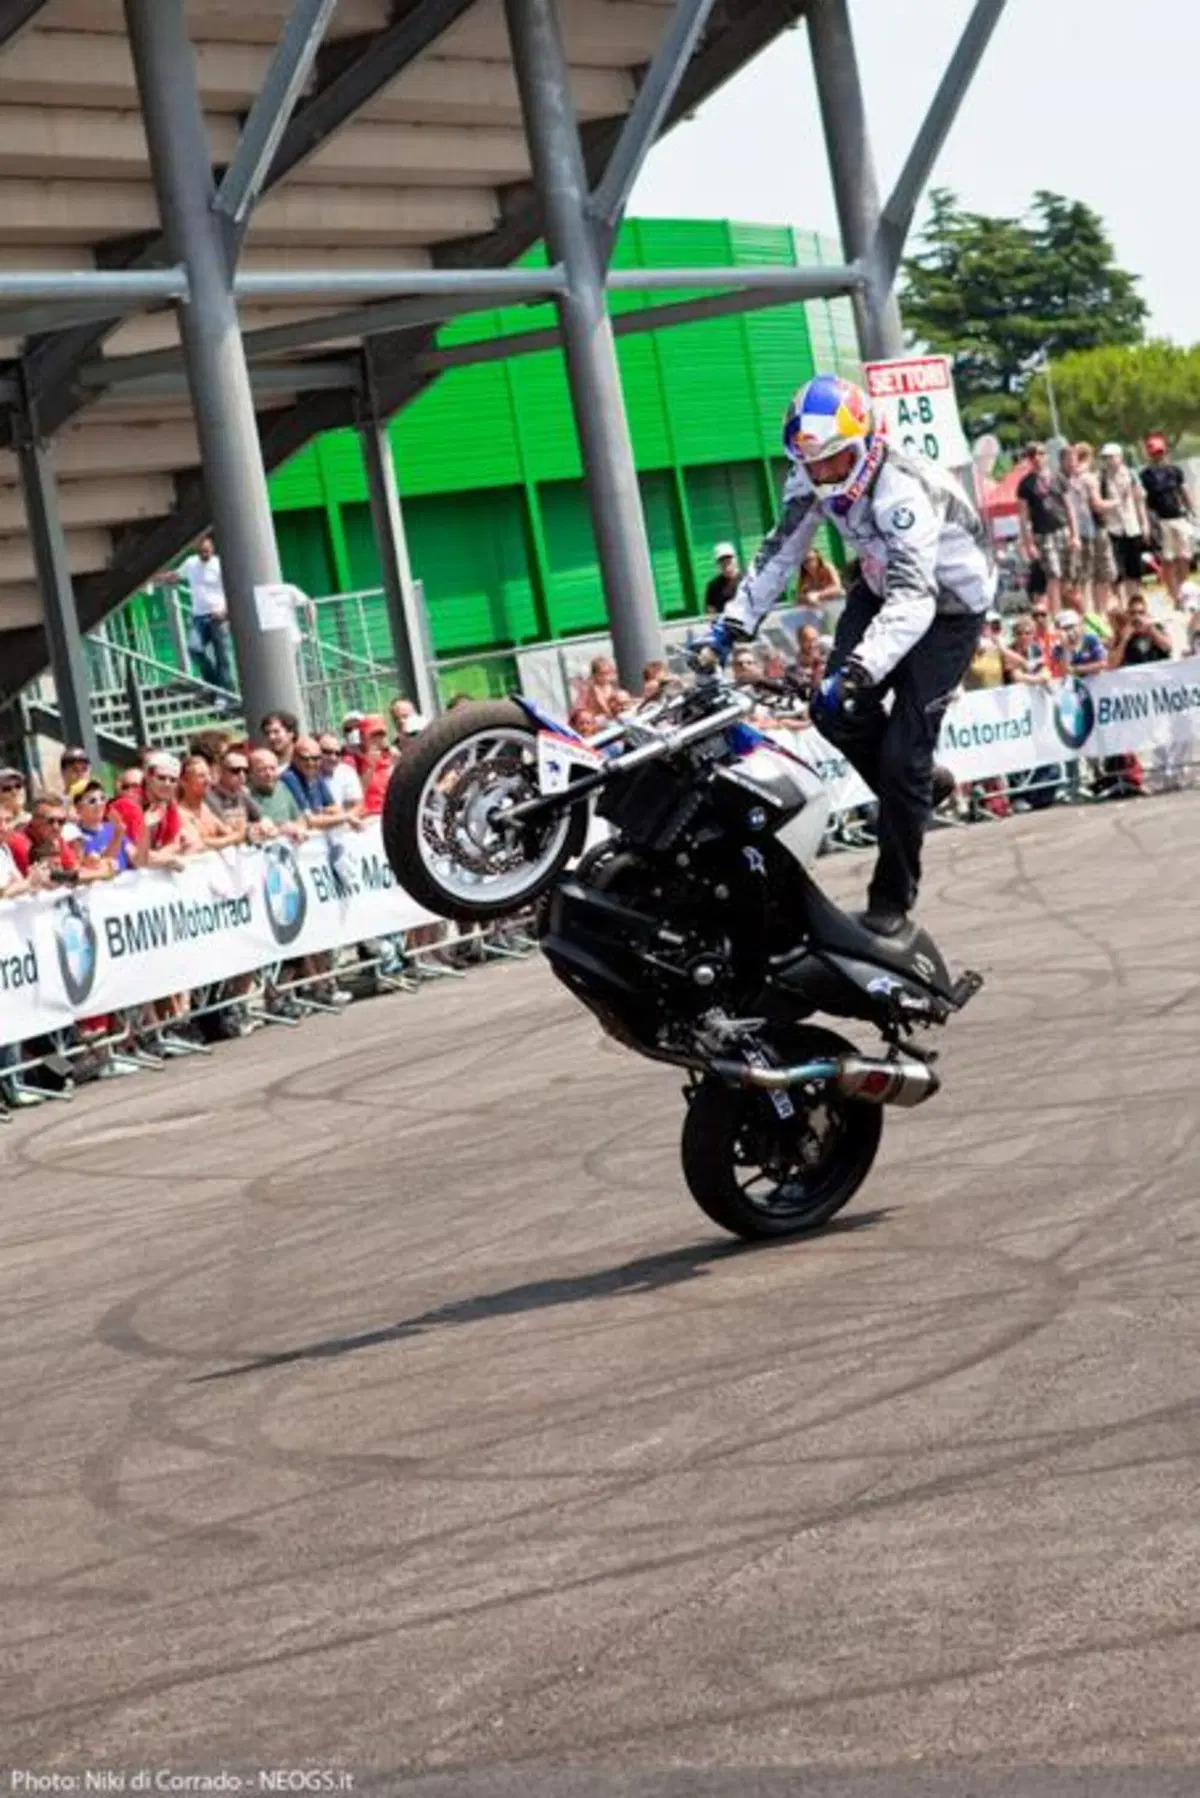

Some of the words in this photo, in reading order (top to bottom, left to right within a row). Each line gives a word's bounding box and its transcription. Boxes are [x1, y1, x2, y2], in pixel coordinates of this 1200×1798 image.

[868, 364, 946, 394] SETTORI
[899, 395, 934, 426] A-B
[1098, 692, 1149, 724] BMW
[104, 906, 168, 958] BMW
[169, 893, 253, 942] Motorrad
